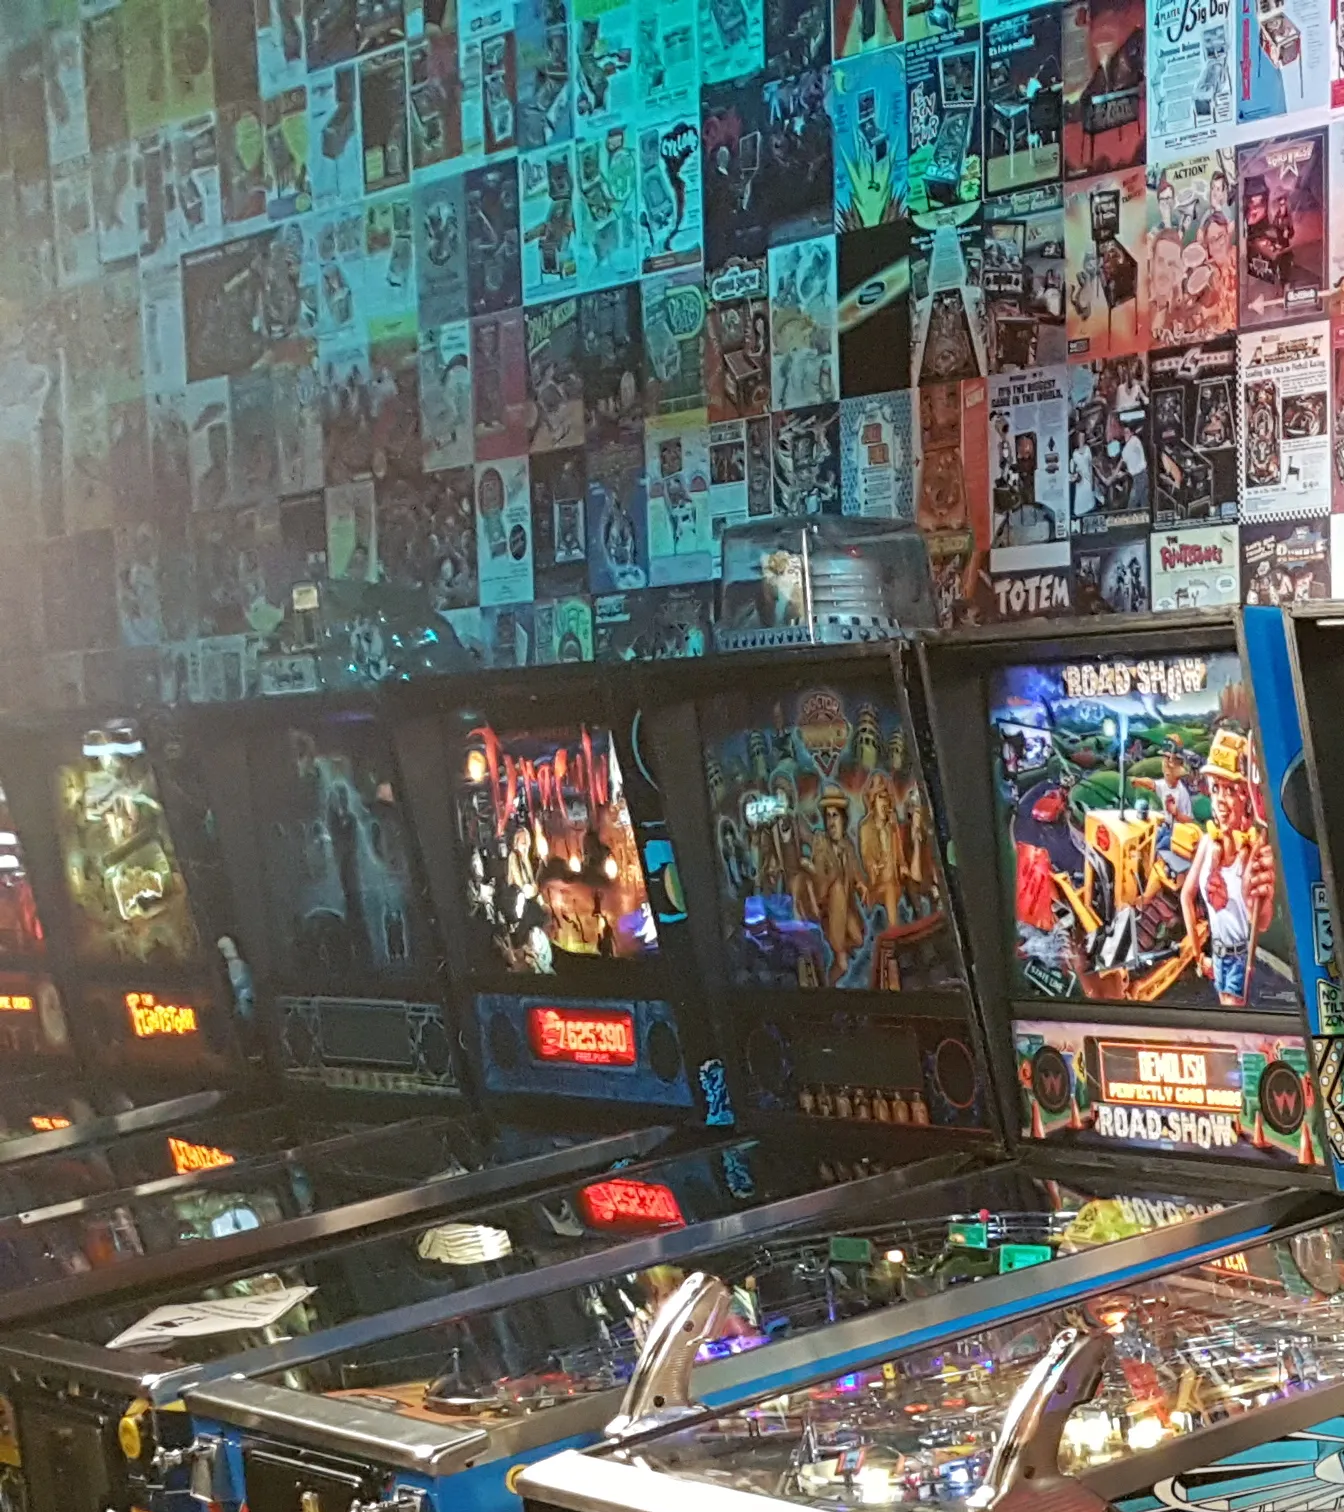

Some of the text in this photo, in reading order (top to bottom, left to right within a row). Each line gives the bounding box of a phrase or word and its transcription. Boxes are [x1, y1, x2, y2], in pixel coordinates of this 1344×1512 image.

[994, 575, 1070, 614] TOTEM
[1065, 658, 1206, 700] ROAD SHOW
[1322, 989, 1338, 1001] NO
[1324, 1001, 1344, 1013] TILT
[1138, 1050, 1207, 1085] DEMOLISH
[1109, 1082, 1173, 1102] PERFECTLY
[1098, 1105, 1237, 1149] ROAD SHOW
